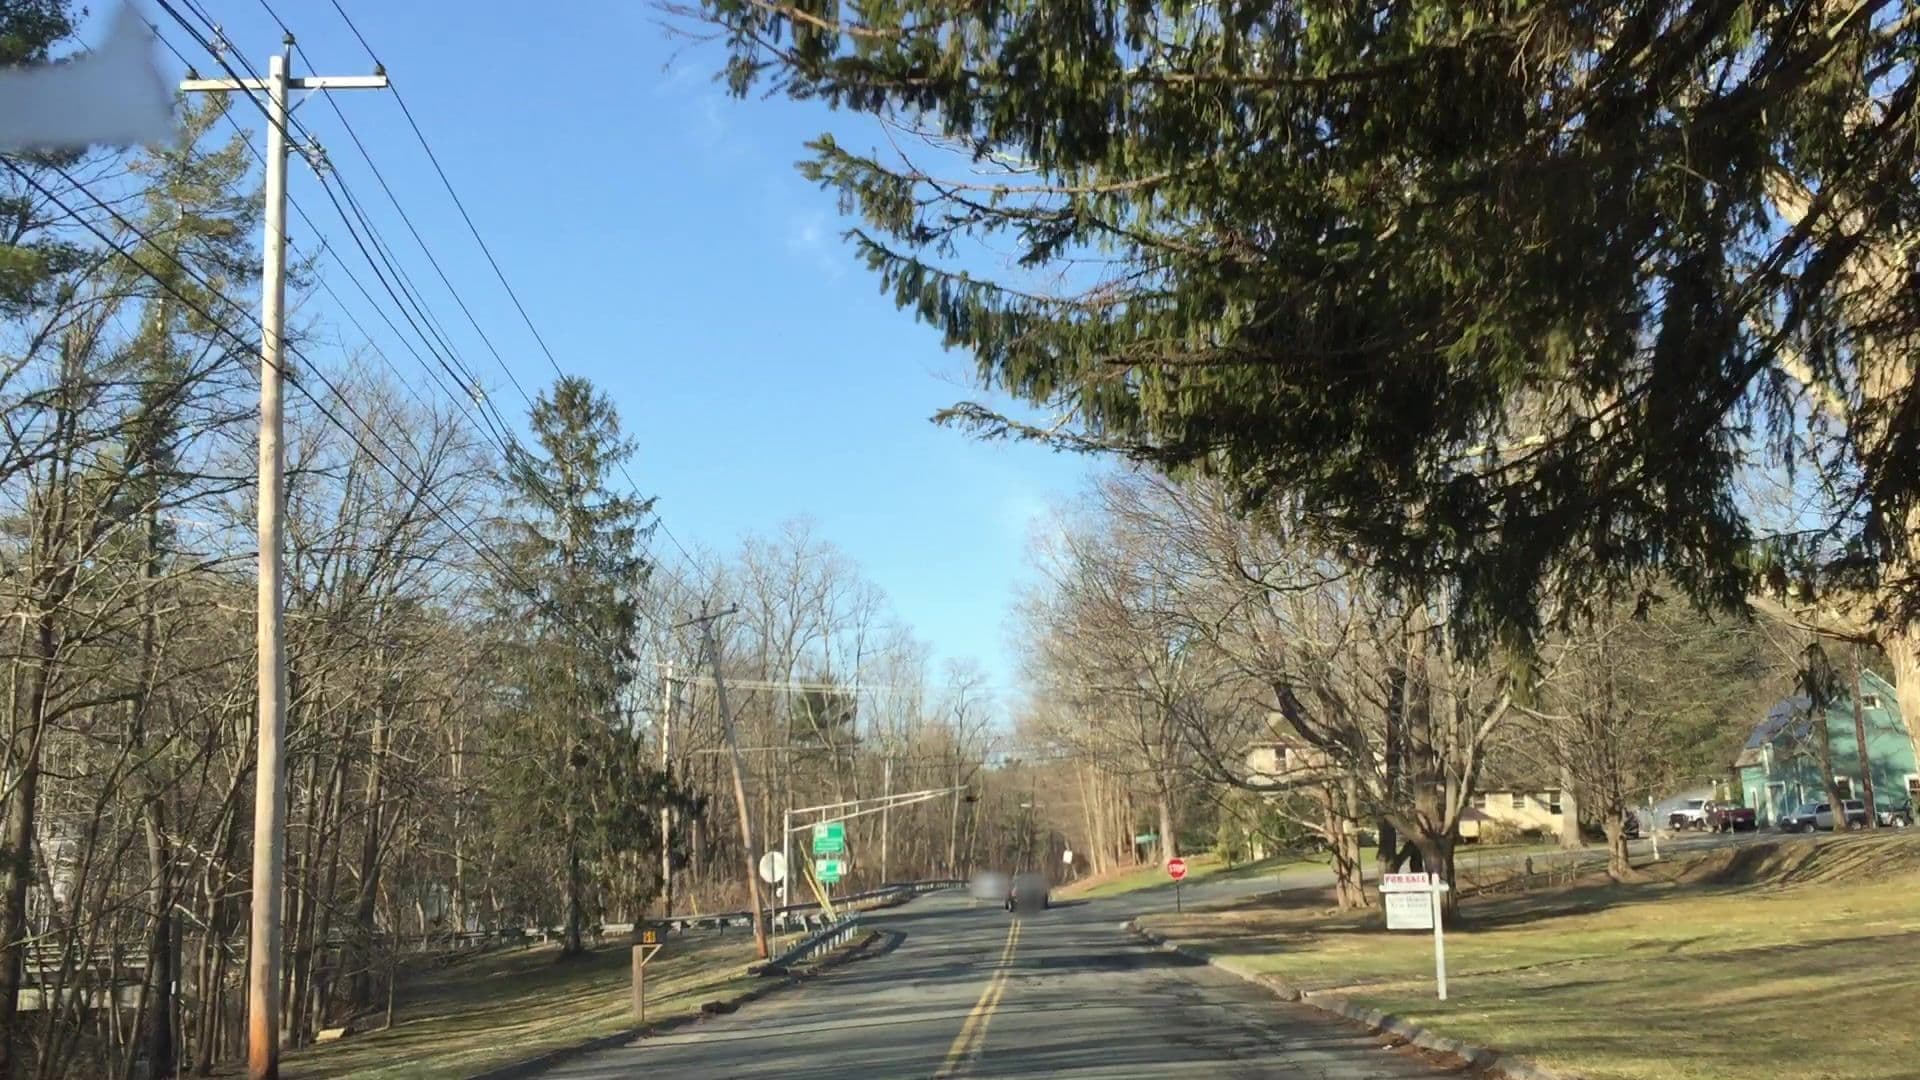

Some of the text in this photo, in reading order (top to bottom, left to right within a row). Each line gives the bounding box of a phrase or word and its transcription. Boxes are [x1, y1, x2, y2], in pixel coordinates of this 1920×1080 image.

[1168, 863, 1185, 873] STOP
[1385, 875, 1426, 883] FOR SALE
